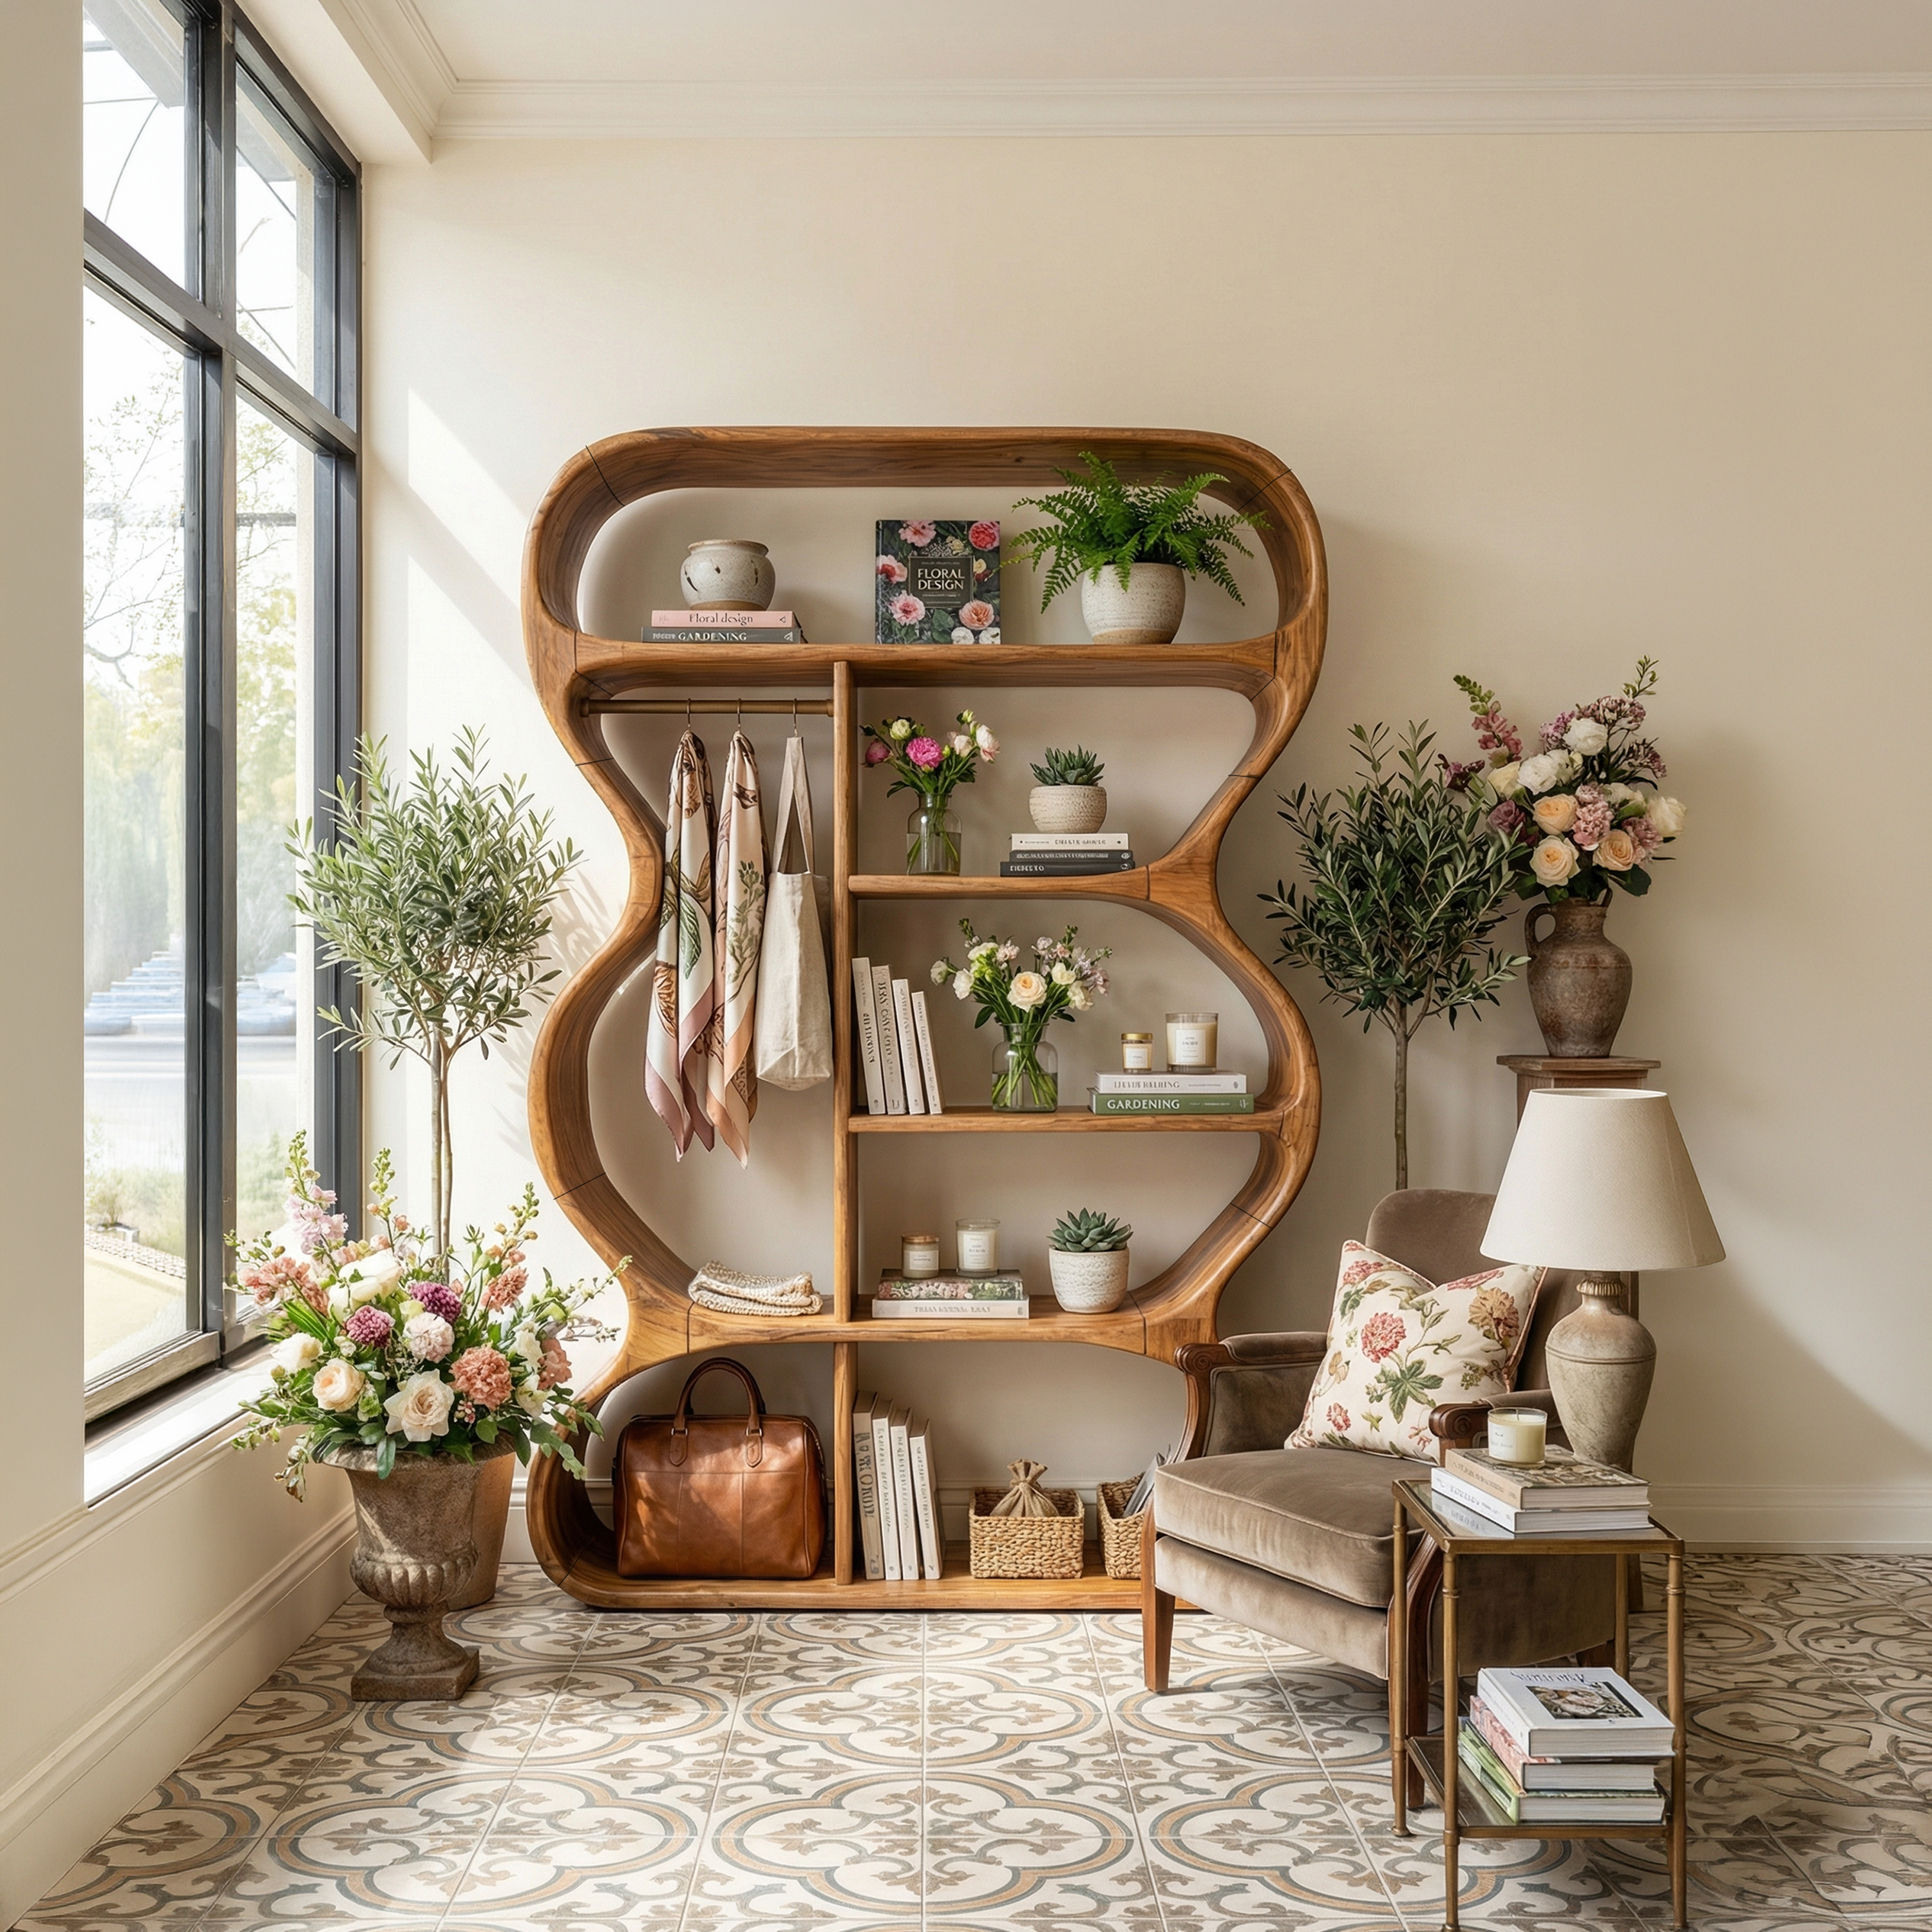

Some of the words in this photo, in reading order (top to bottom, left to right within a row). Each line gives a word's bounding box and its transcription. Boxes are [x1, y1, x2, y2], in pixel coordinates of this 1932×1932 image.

[918, 568, 965, 579] FLORAL
[918, 580, 964, 590] DESIGN
[690, 612, 718, 623] Floral
[678, 632, 747, 641] GARDENING
[1106, 1099, 1180, 1110] GARDENING
